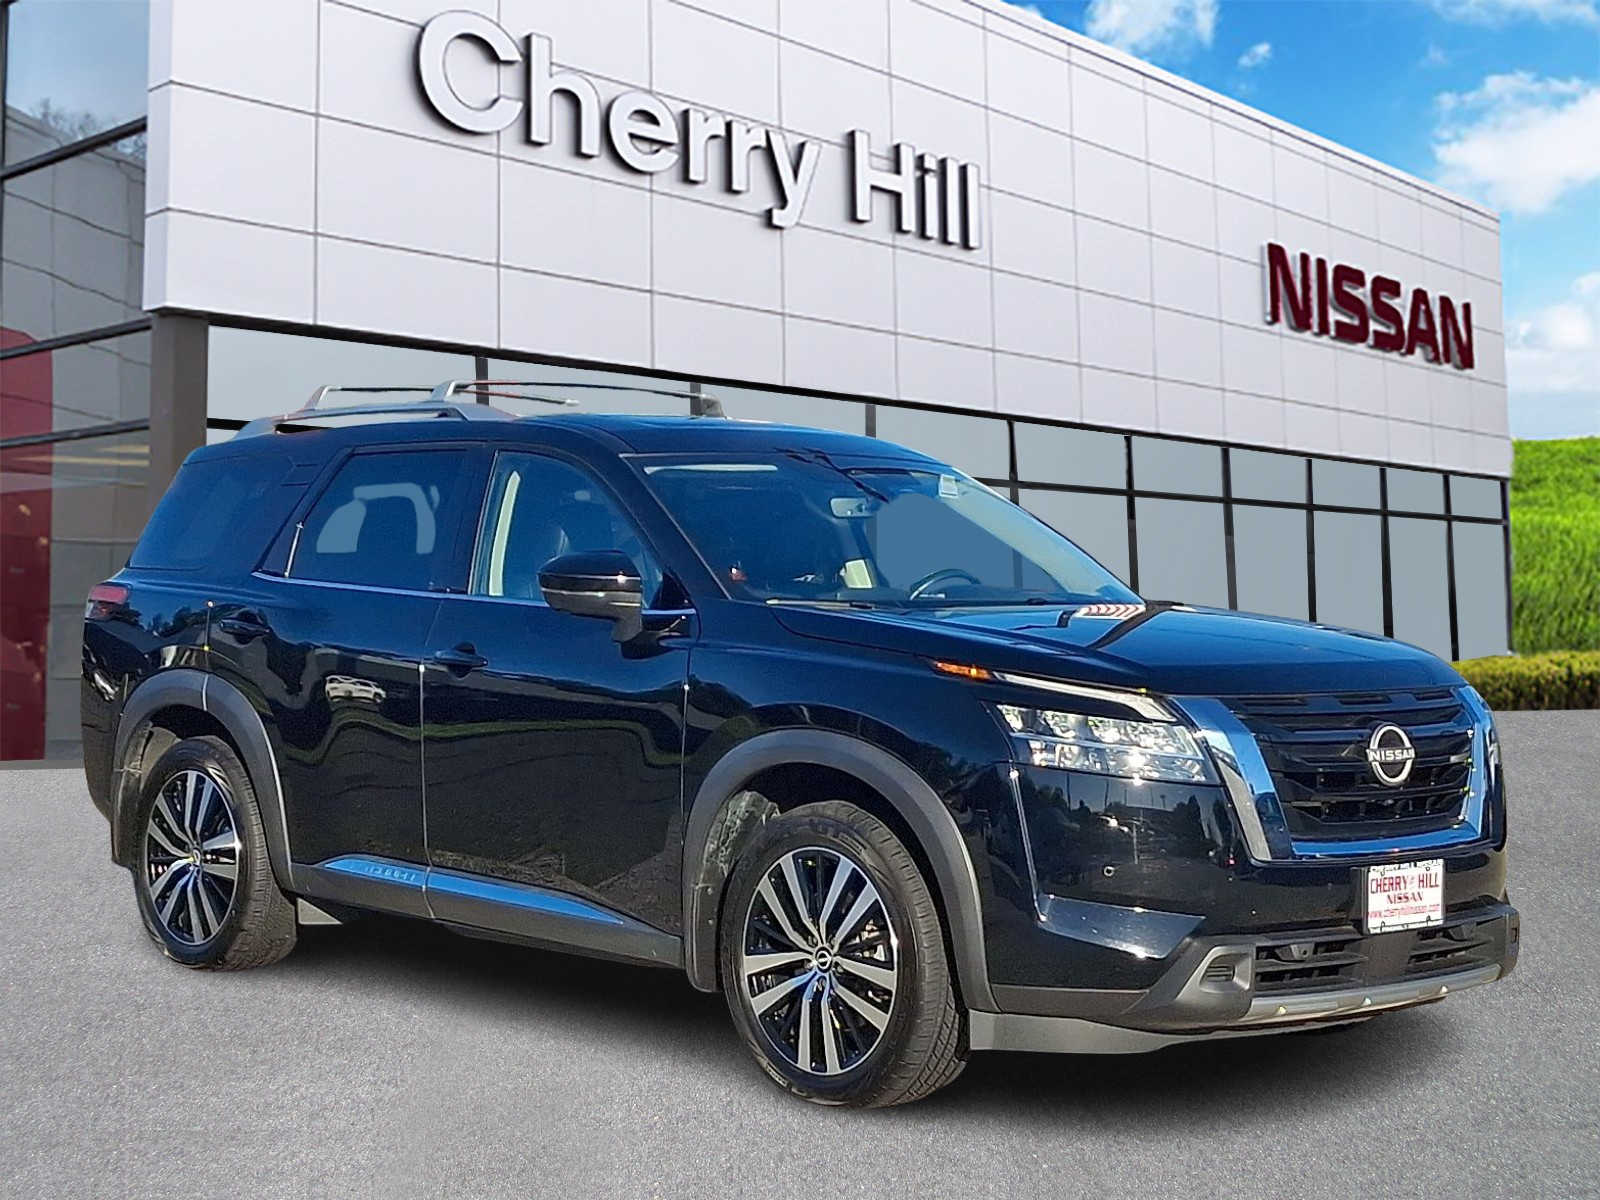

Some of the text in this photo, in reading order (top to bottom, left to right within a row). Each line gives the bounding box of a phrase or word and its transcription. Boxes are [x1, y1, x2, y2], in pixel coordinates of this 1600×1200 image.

[416, 9, 981, 250] Cherry Hill
[1266, 242, 1475, 370] NISSAN
[1370, 872, 1440, 894] CHERRY HILL
[1387, 891, 1424, 904] NISSAN
